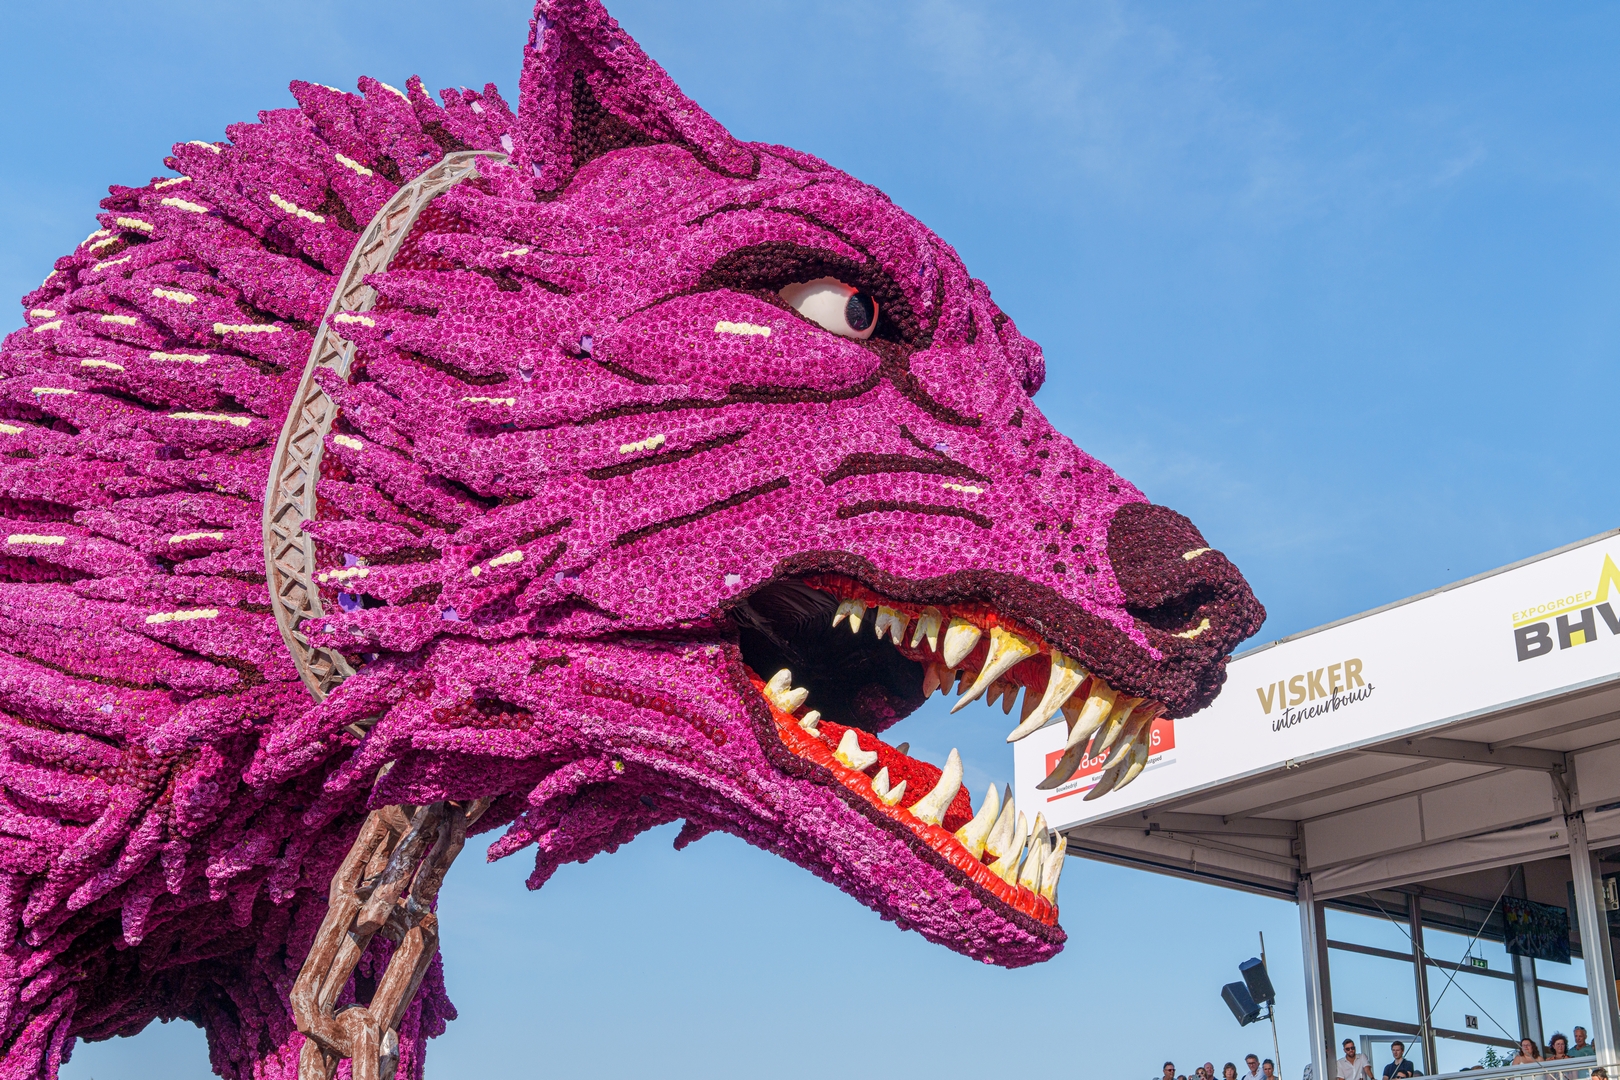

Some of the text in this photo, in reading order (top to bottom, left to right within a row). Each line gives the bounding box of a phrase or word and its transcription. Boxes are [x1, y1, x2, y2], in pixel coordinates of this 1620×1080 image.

[1512, 590, 1592, 622] EXPOGROEP
[1256, 658, 1365, 715] VISKER
[1272, 683, 1375, 732] interieurbouw
[1466, 1016, 1477, 1028] 14
